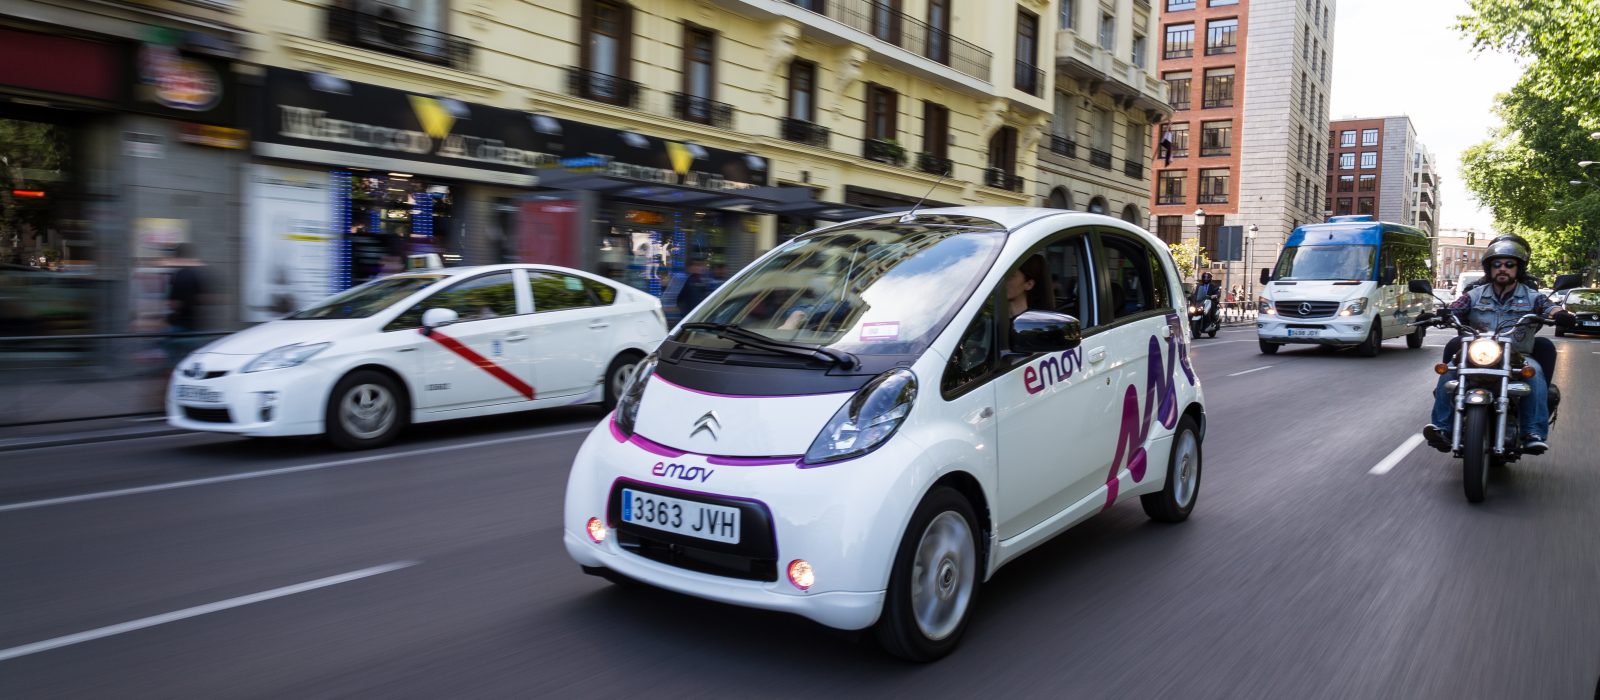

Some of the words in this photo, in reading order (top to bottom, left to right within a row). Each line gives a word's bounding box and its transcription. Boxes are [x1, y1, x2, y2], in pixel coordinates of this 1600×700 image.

[1025, 346, 1083, 395] emov
[653, 461, 714, 482] emov
[634, 497, 682, 528] 3363
[691, 507, 734, 538] JVH
